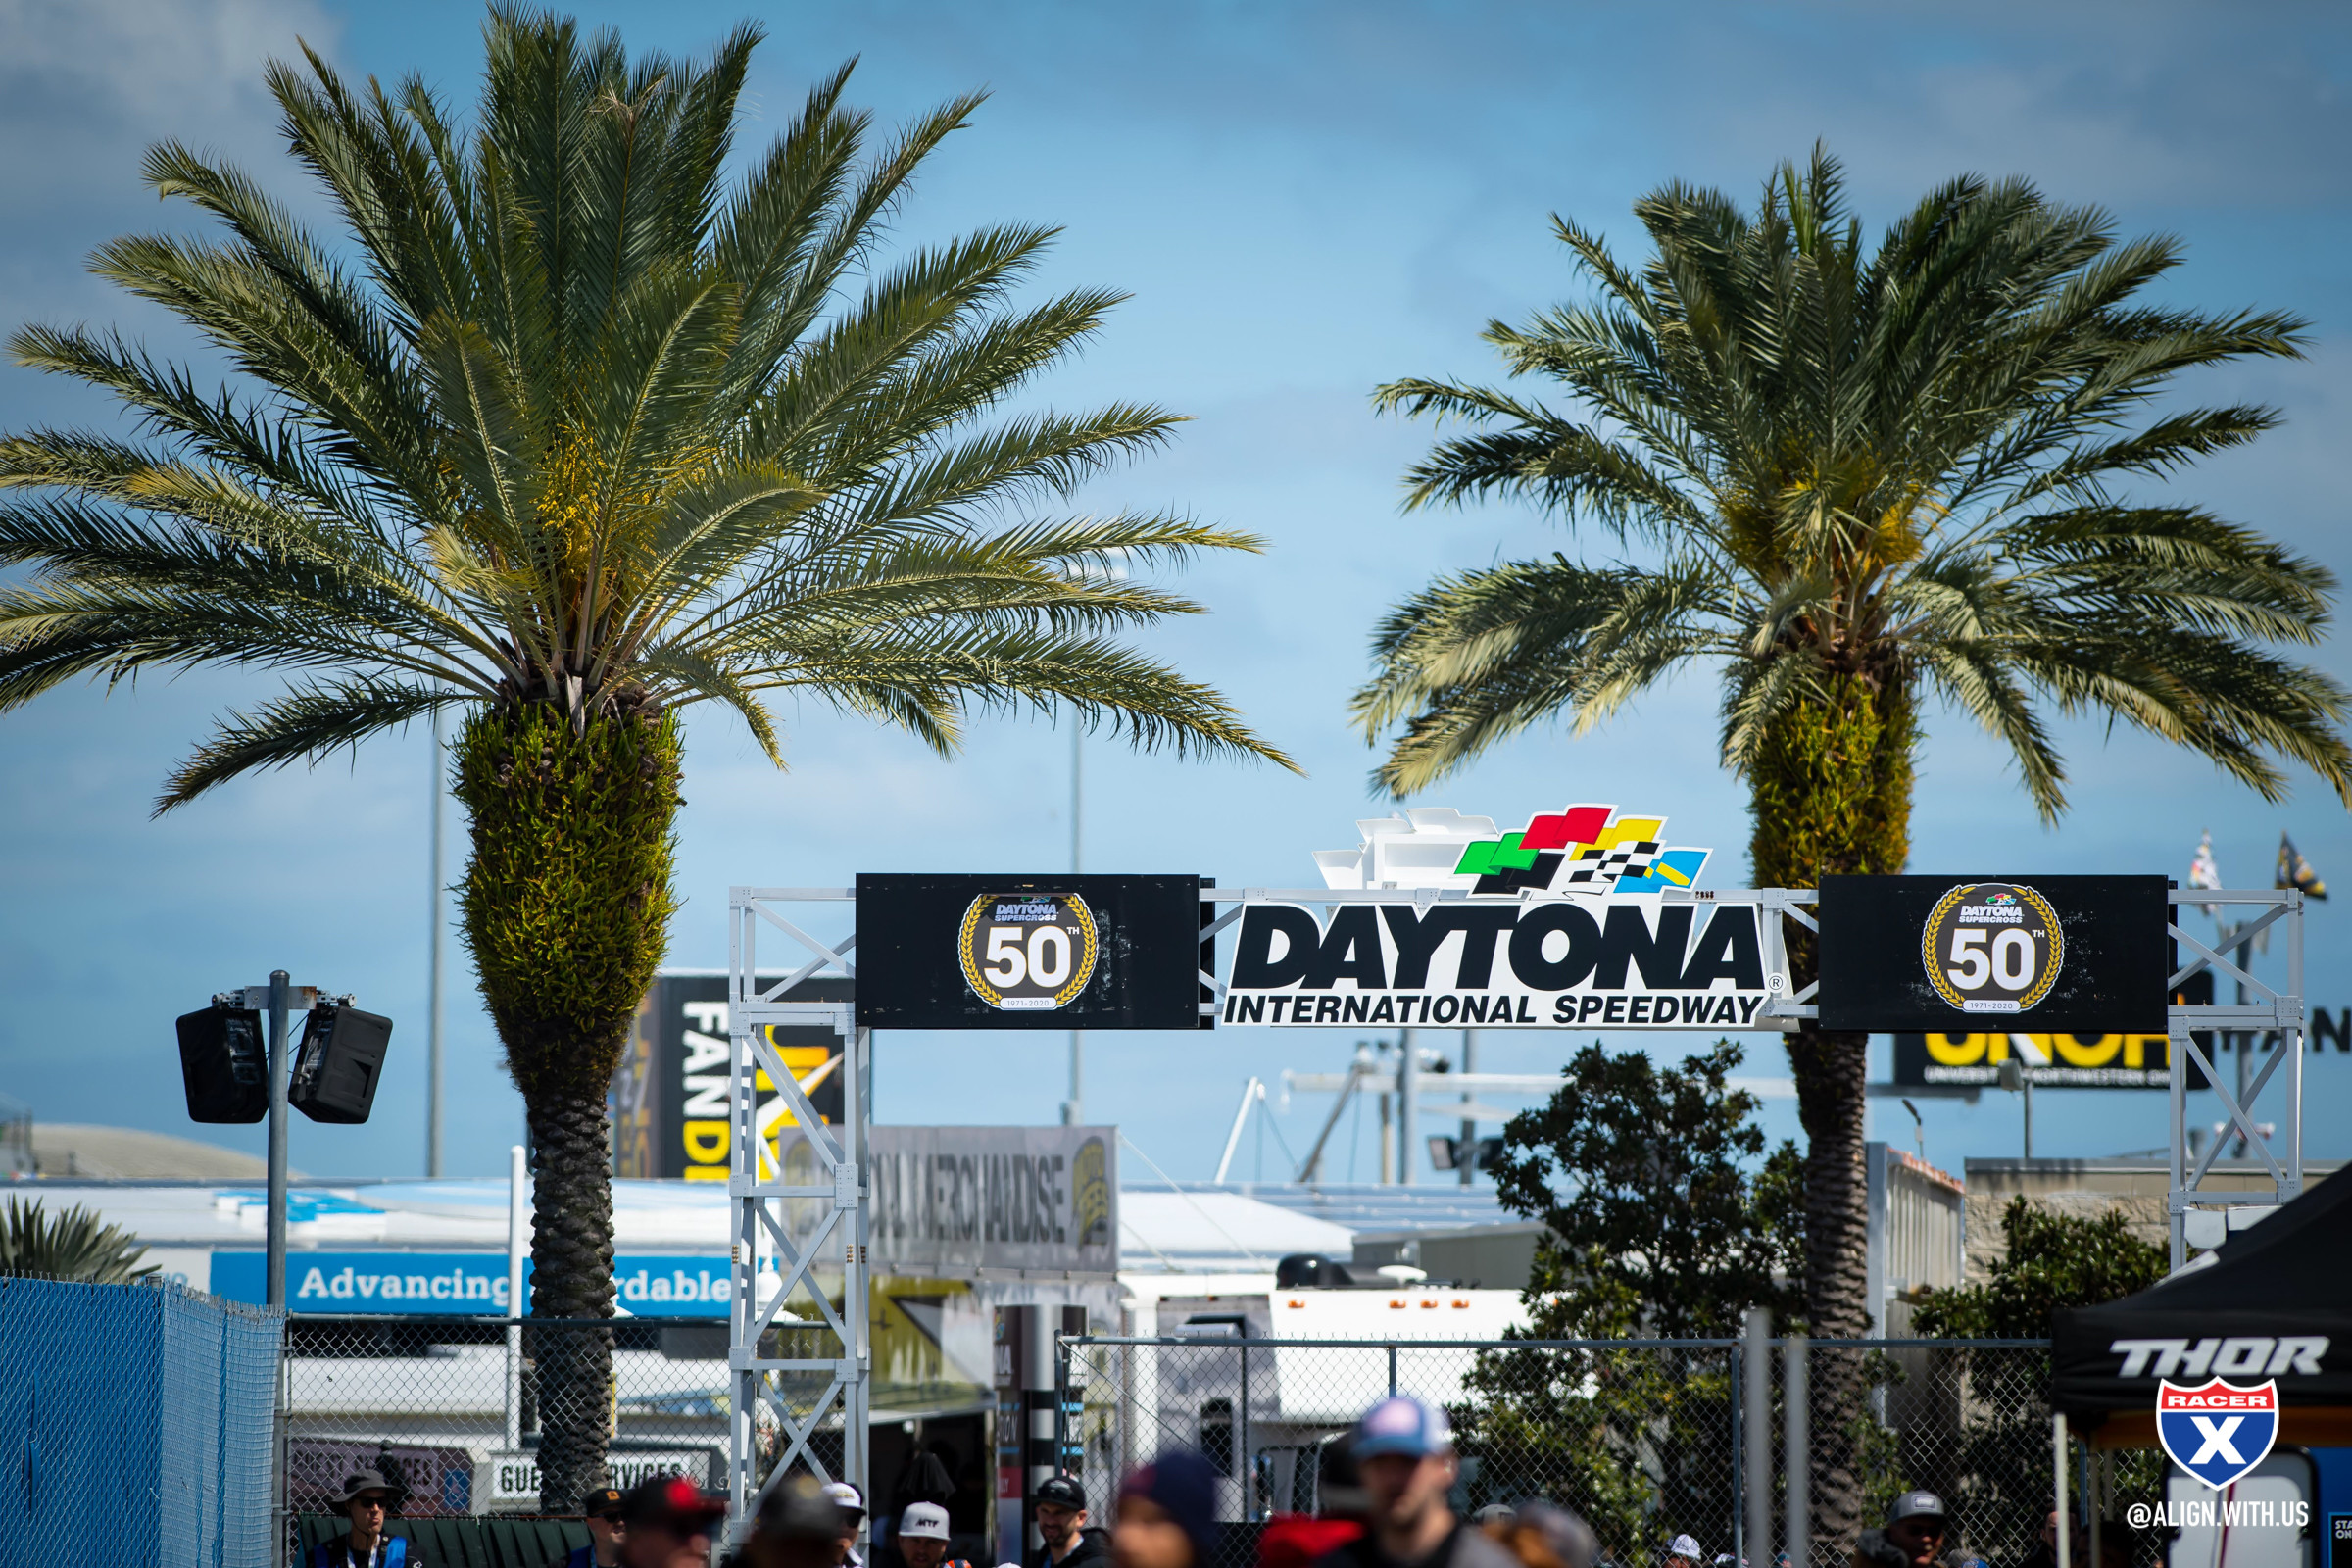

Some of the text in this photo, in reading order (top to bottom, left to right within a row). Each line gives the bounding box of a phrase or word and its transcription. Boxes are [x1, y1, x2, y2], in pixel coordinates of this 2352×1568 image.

[996, 904, 1057, 915] DAYTONA
[1960, 905, 2025, 917] DAYTONA
[1231, 903, 1766, 991] DAYTONA
[1224, 995, 1764, 1024] INTERNATIONAL SPEEDWAY
[1970, 1002, 2014, 1010] 1971-2020
[297, 1266, 509, 1306] Advancing
[2109, 1336, 2331, 1377] THOR
[501, 1462, 682, 1492] GUE RVICES
